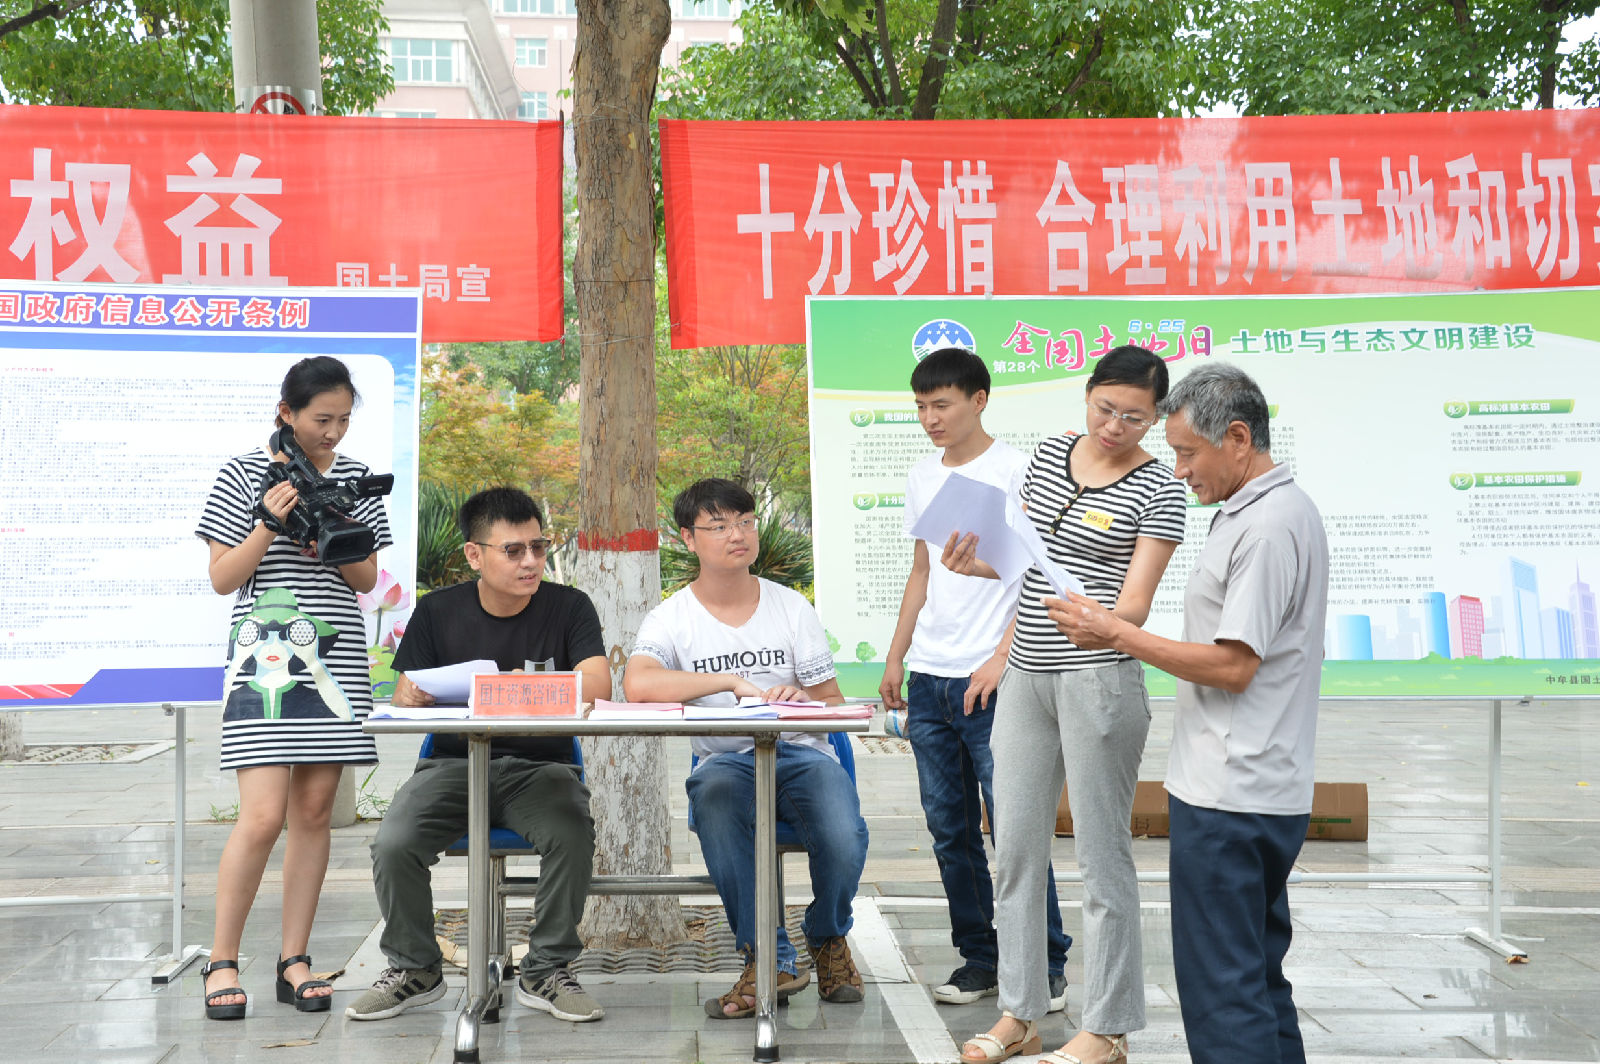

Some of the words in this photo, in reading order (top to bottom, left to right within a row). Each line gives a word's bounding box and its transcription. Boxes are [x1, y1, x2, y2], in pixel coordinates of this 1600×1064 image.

[9, 147, 288, 284] 权益
[737, 158, 998, 299] 十分珍惜
[1036, 152, 1600, 292] 合理利用土地和切
[335, 261, 491, 303] 国土局宣
[1230, 323, 1536, 355] 土地与生态文明建设
[993, 360, 1040, 373] 第28个
[480, 683, 570, 706] 国土资源咨询台
